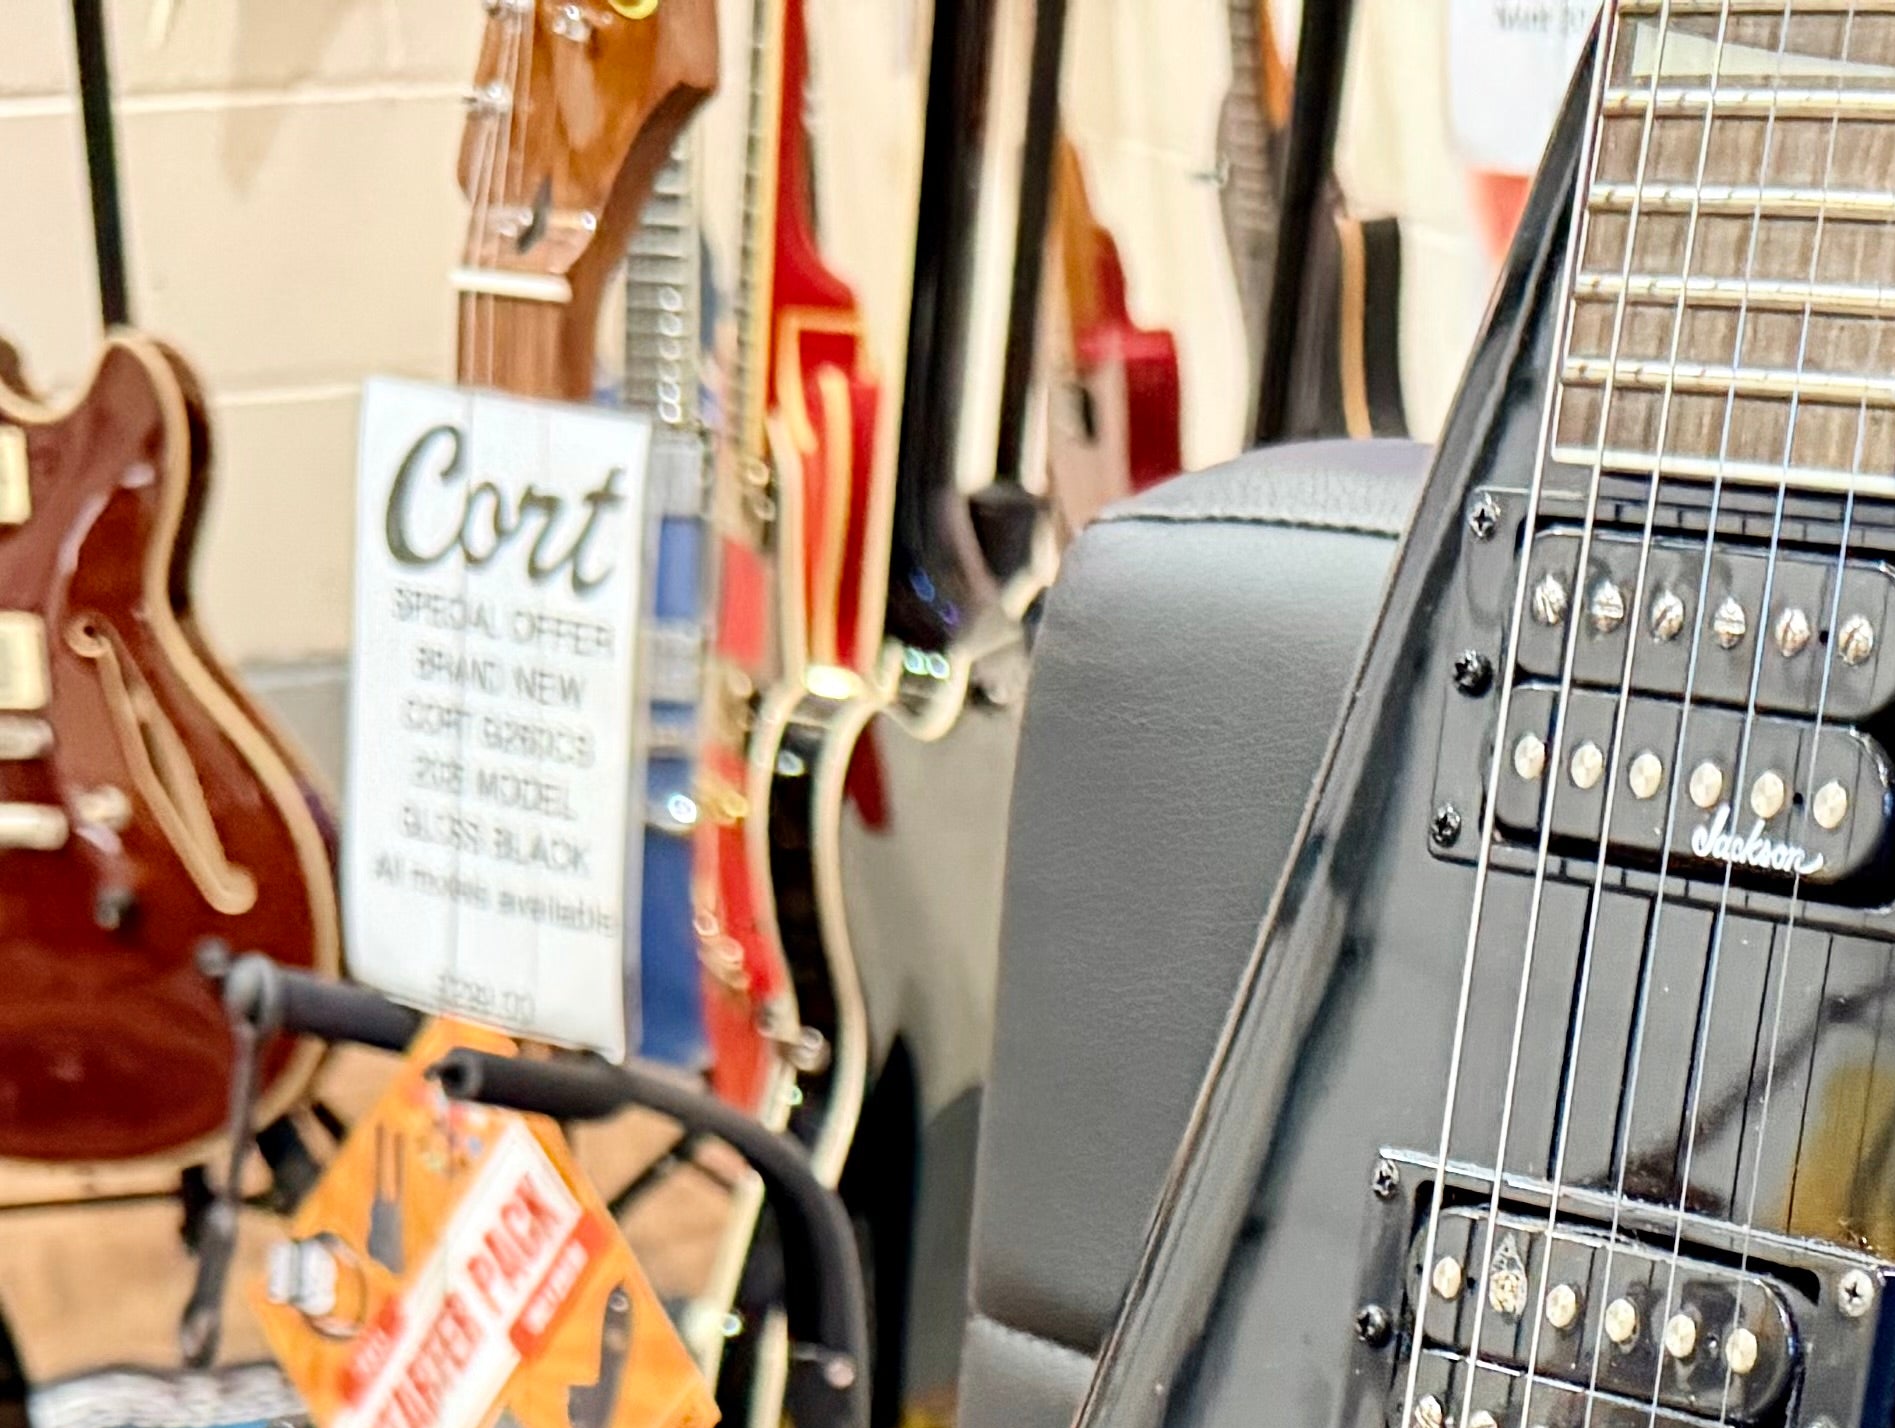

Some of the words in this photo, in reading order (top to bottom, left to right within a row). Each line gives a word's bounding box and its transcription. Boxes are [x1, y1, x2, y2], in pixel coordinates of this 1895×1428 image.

[386, 425, 626, 595] Cort
[394, 587, 499, 640] SPECIAL
[513, 609, 616, 658] OFFER
[415, 646, 502, 695] BRAND
[513, 664, 586, 709] NEW
[477, 767, 577, 821] MODEL
[493, 826, 591, 877] BLACK
[1691, 802, 1824, 874] Jackson
[467, 1171, 562, 1317] PACK
